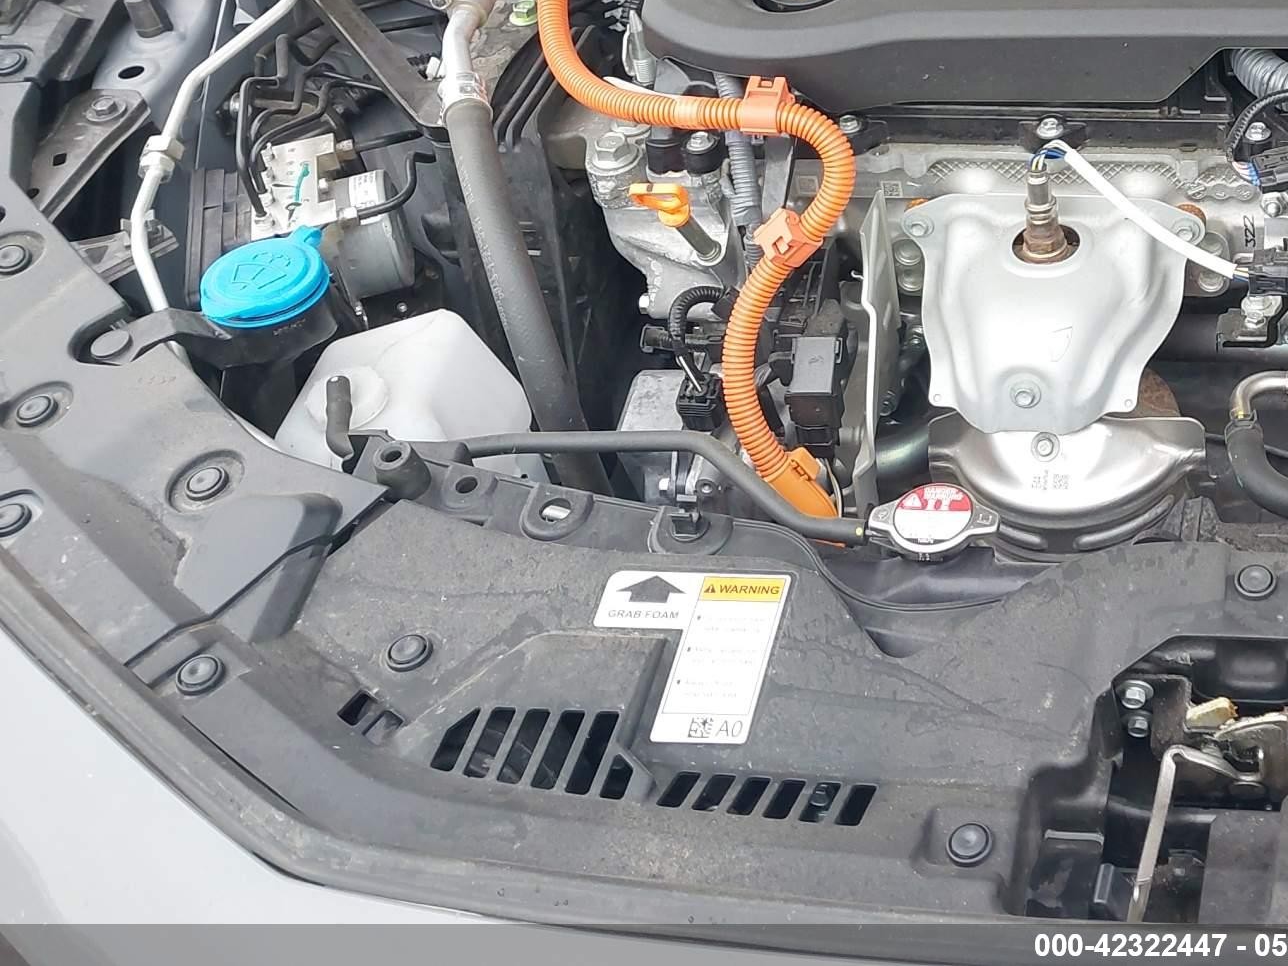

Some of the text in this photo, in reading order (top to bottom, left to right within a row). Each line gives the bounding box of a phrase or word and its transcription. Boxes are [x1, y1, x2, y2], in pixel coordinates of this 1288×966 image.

[719, 585, 780, 595] WARNING
[608, 609, 679, 619] GRAB FOAM
